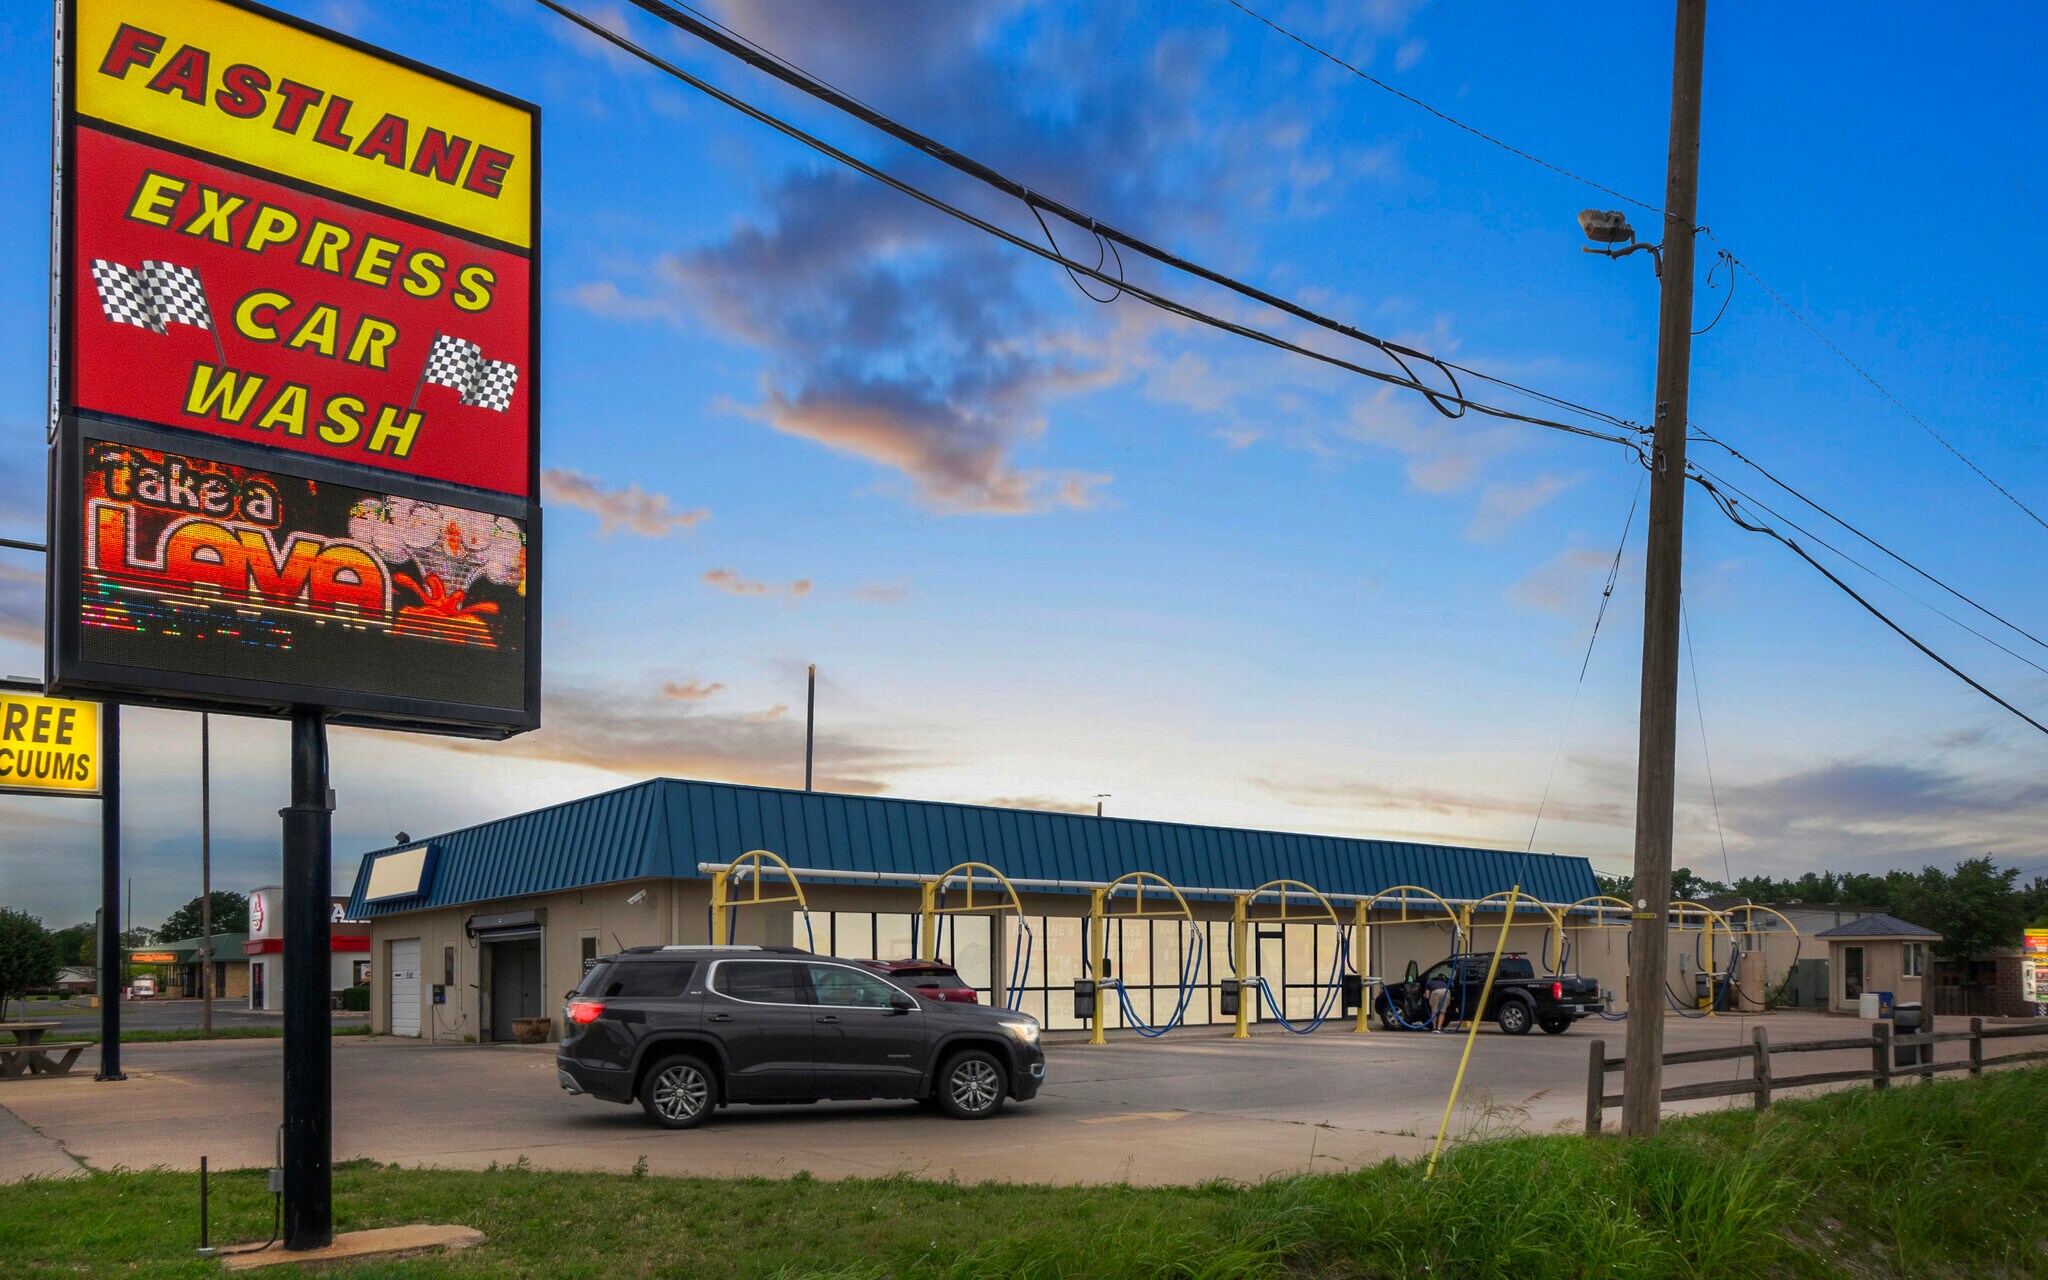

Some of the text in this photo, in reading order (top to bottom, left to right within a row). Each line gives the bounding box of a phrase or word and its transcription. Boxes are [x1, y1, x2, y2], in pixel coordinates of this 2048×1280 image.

[98, 22, 516, 200] FASTLANE
[124, 167, 498, 313] EXPRESS
[232, 288, 398, 371] CAR
[181, 360, 427, 458] WASH
[0, 701, 77, 746] REE
